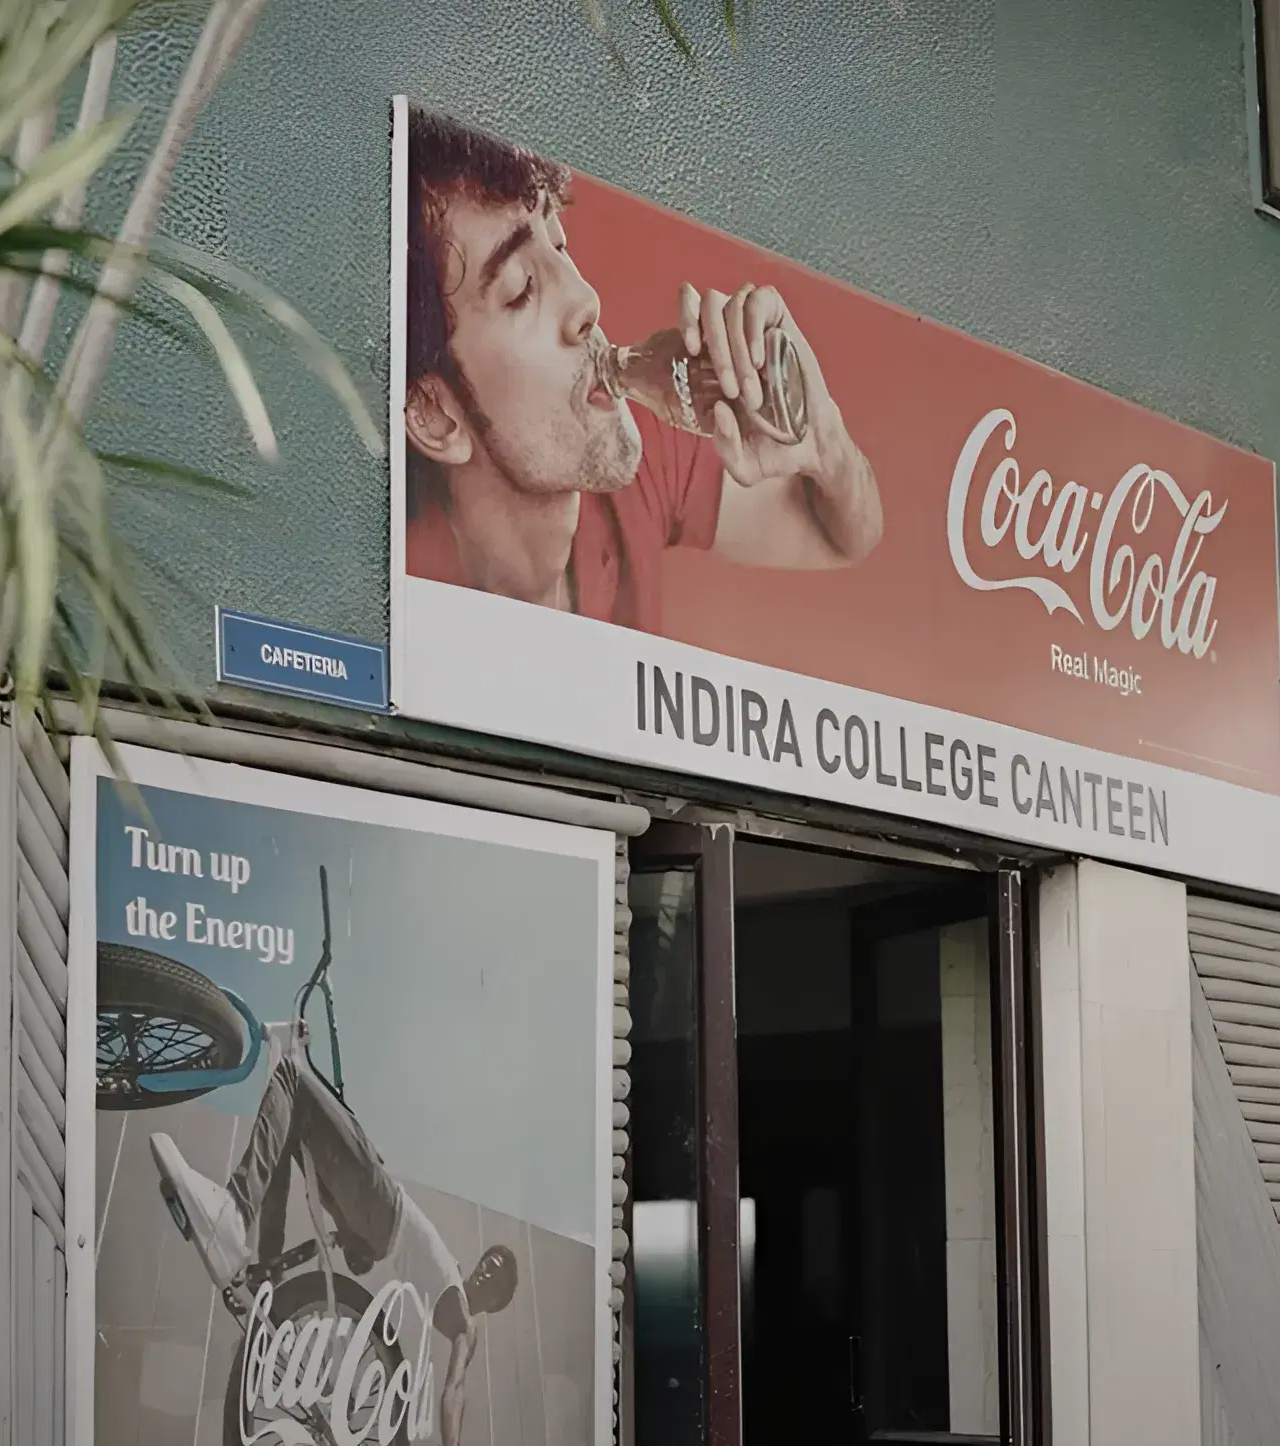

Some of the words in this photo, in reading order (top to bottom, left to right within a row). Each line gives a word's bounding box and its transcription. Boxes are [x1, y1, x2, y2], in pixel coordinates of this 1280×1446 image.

[260, 643, 348, 681] CAFETERIA
[1050, 643, 1090, 680] Real
[1094, 656, 1142, 697] Magic
[635, 660, 803, 767] INDIRA
[815, 707, 999, 808] COLLEGE
[1010, 753, 1170, 847] CANTEEN
[124, 825, 204, 878] Turn
[210, 852, 251, 894] up
[125, 896, 178, 941] the
[186, 902, 295, 965] Energy
